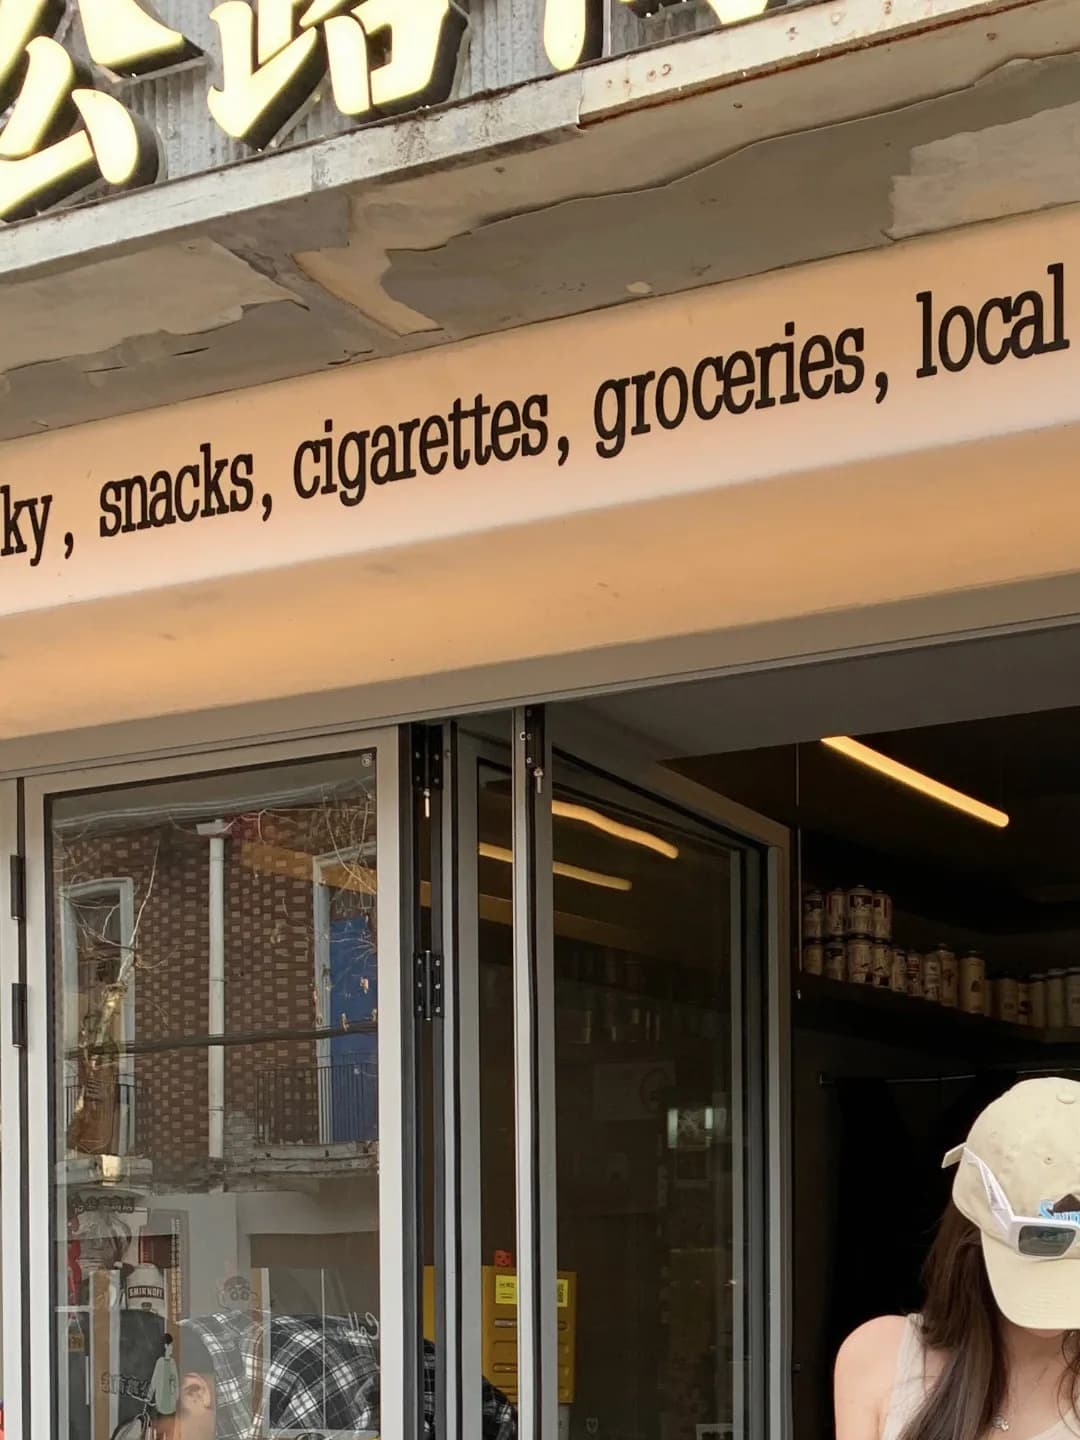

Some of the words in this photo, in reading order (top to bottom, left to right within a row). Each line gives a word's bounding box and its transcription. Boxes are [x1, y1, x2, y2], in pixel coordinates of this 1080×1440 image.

[99, 443, 273, 538] snacks,
[293, 392, 570, 507] cigarettes,
[594, 321, 889, 459] groceries,
[916, 262, 1070, 379] local
